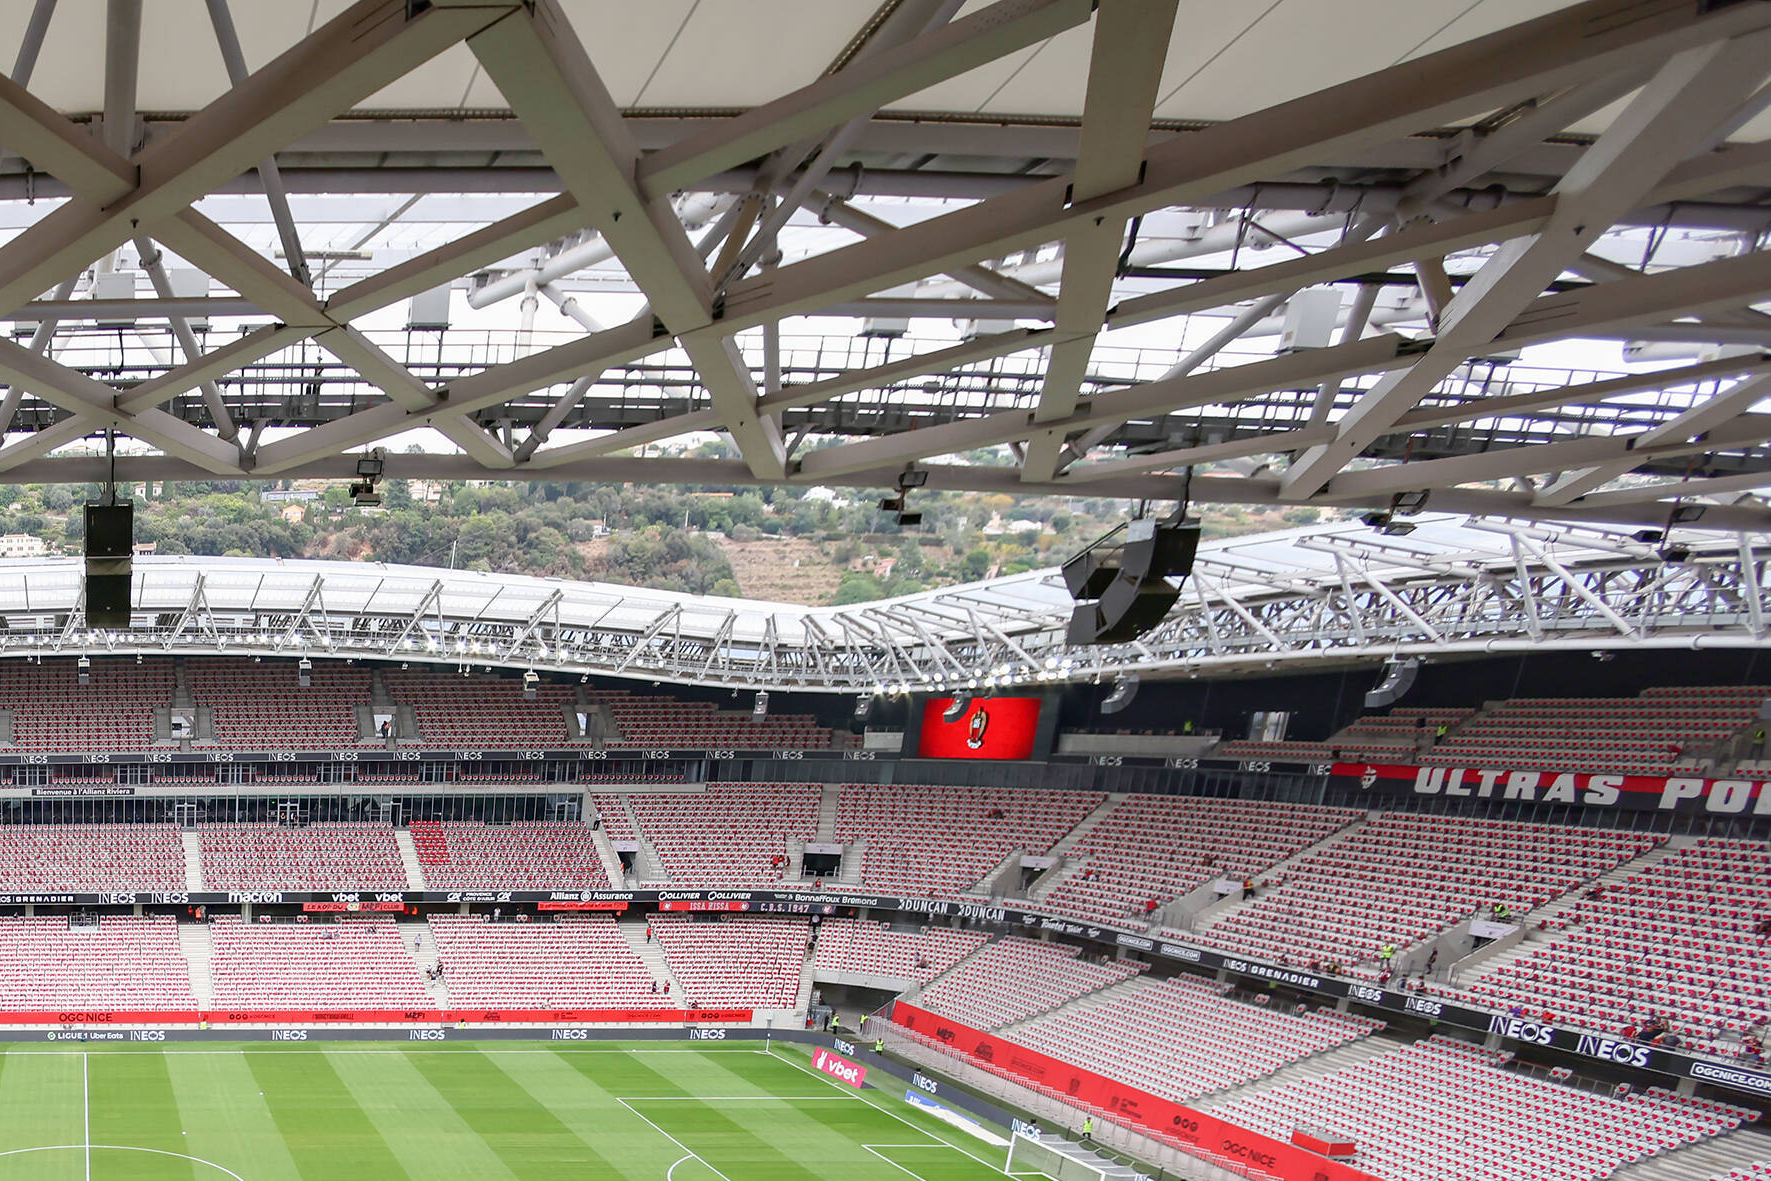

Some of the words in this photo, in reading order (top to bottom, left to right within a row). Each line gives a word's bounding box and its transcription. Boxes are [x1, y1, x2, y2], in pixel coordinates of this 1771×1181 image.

[82, 754, 110, 764] INEOS
[268, 752, 296, 762] INEOS
[455, 751, 483, 761] INEOS
[642, 751, 670, 760] INEOS
[844, 751, 876, 761] INEOS
[1239, 760, 1270, 772] INEOS
[1414, 766, 1624, 806] ULTRAS
[98, 893, 136, 903] INEOS
[151, 893, 188, 903] INEOS
[228, 892, 282, 903] macron
[331, 893, 359, 902] vbet
[375, 893, 403, 902] vbet
[550, 892, 580, 900] Allianz
[592, 892, 633, 900] Assurance
[795, 894, 840, 903] Bonnaffoux
[905, 900, 948, 914] DUNCAN
[965, 906, 1005, 921] DUNCAN
[1224, 958, 1247, 972] INEOS
[1251, 965, 1319, 988] GRENADIER
[1349, 985, 1382, 1001] INEOS
[1405, 997, 1442, 1015] INEOS
[59, 1014, 84, 1022] OGC
[86, 1014, 113, 1022] NICE
[272, 1030, 308, 1040] INEOS
[409, 1030, 445, 1040] INEOS
[551, 1029, 587, 1039] INEOS
[690, 1029, 726, 1040] INEOS
[1489, 1016, 1554, 1045] INEOS
[58, 1032, 83, 1040] LIGUE
[90, 1032, 106, 1040] Uber
[107, 1032, 124, 1040] Eats
[130, 1031, 165, 1041] INEOS
[834, 1038, 855, 1056] INEOS
[1575, 1035, 1650, 1067] INEOS
[828, 1058, 859, 1083] vbet
[912, 1071, 938, 1093] INEOS
[1011, 1118, 1042, 1141] INEOS
[1222, 1139, 1247, 1157] OGC
[1249, 1149, 1277, 1169] NICE
